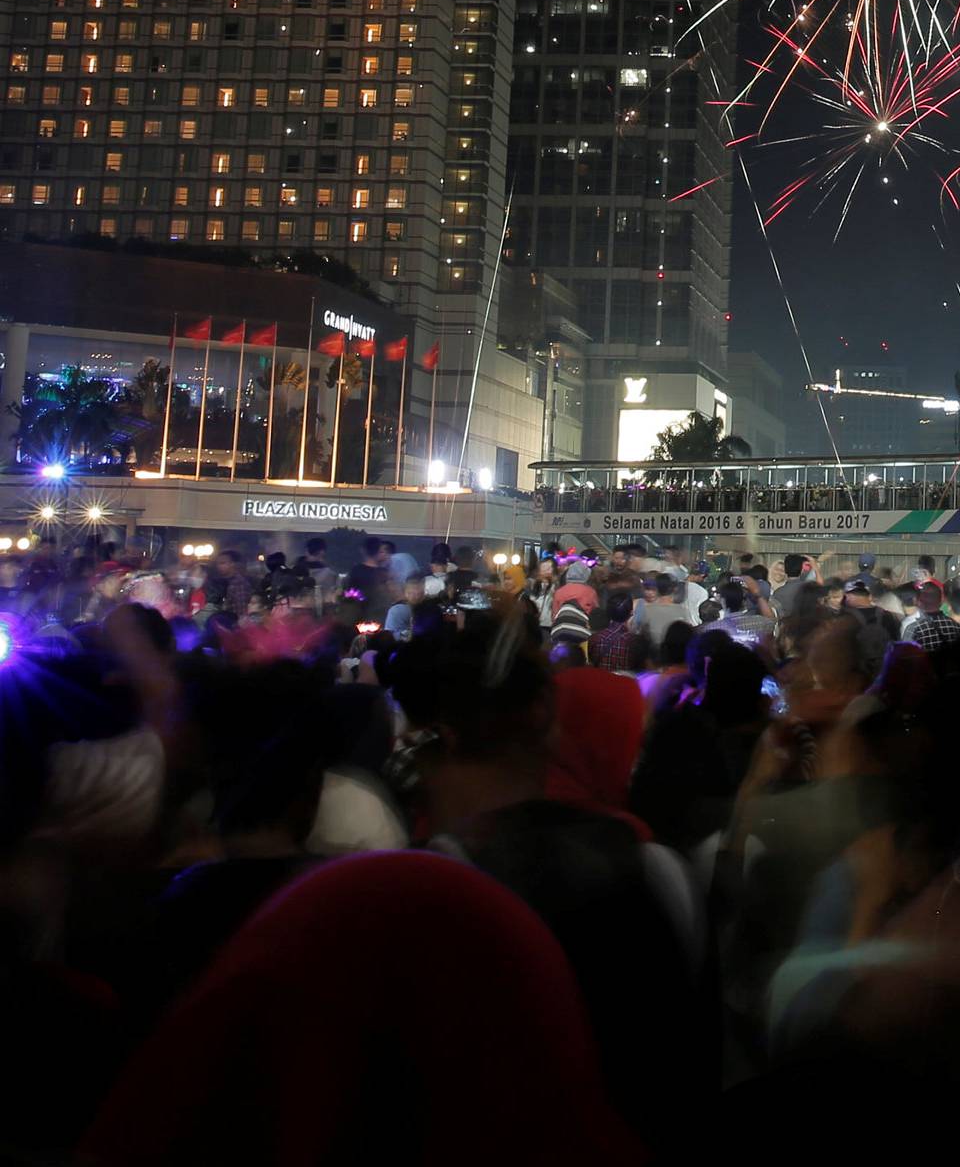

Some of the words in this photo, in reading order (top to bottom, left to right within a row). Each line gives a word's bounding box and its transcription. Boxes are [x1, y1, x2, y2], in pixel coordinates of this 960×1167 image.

[325, 310, 349, 334] GRAND
[353, 322, 375, 342] HYATT
[245, 500, 296, 517] PLAZA
[299, 503, 387, 521] INDONESIA
[603, 515, 655, 530] Selamat
[660, 515, 694, 530] Natal
[698, 515, 730, 530] 2016
[736, 515, 745, 530] &
[798, 515, 832, 530] Baru
[836, 514, 870, 530] 2017
